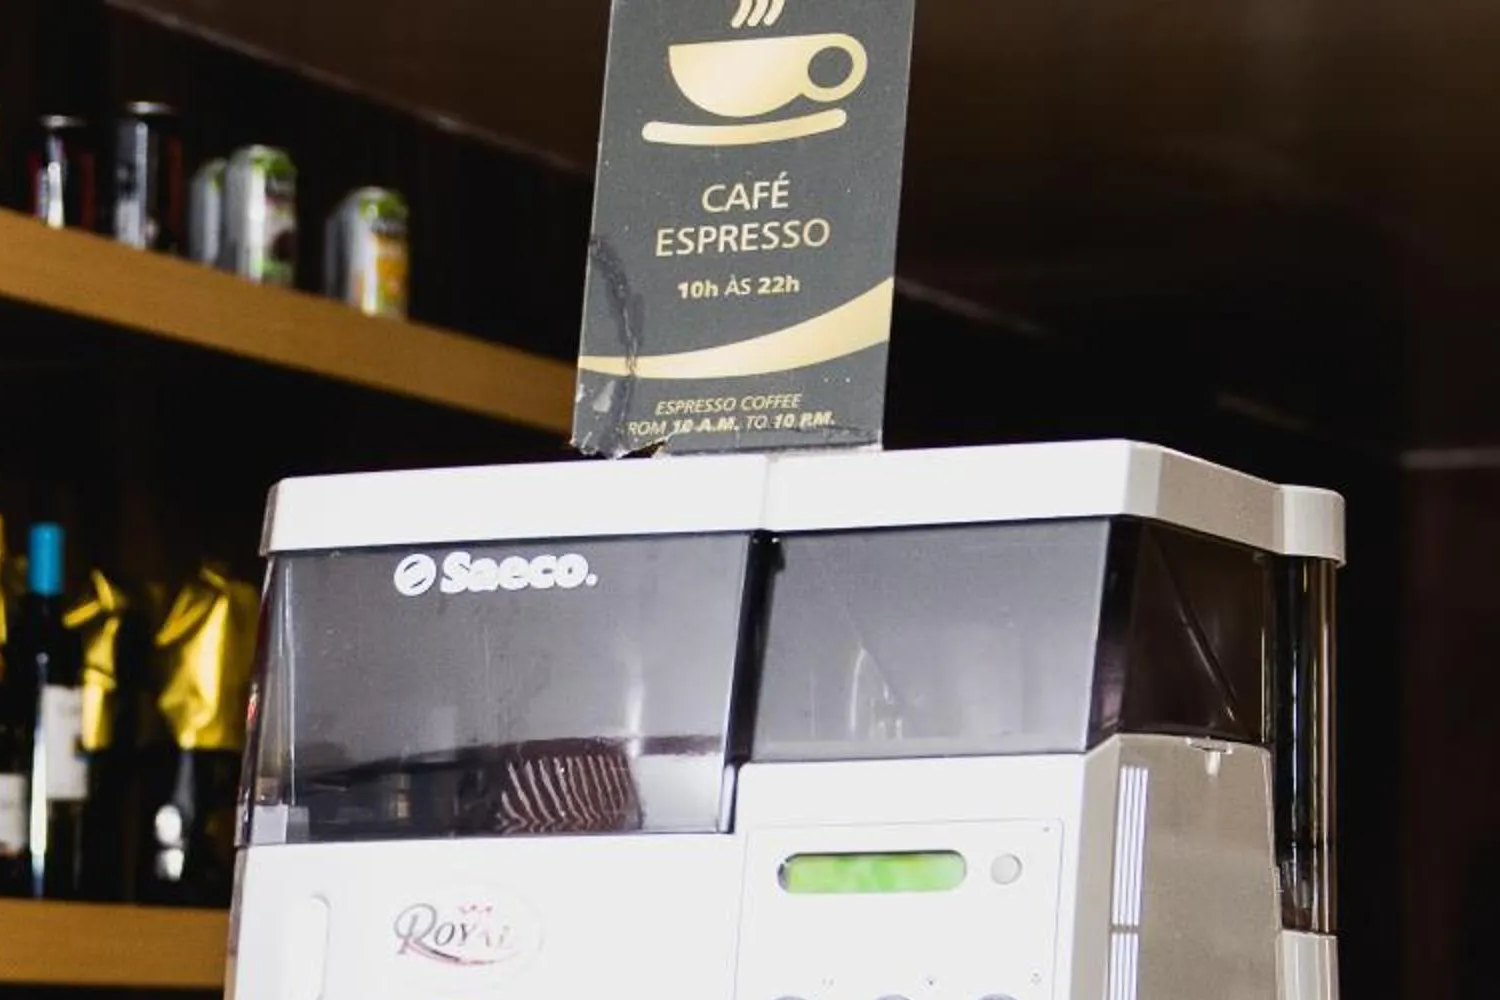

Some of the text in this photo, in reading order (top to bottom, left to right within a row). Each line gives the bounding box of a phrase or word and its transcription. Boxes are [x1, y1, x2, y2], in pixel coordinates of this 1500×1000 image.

[702, 171, 791, 213] CAFÉ
[655, 217, 831, 257] ESPRESSO
[677, 280, 719, 300] 10h
[756, 275, 801, 295] 22h
[655, 393, 803, 417] ESPRESSO COFFEE
[625, 420, 668, 436] ROM
[746, 414, 768, 431] TO
